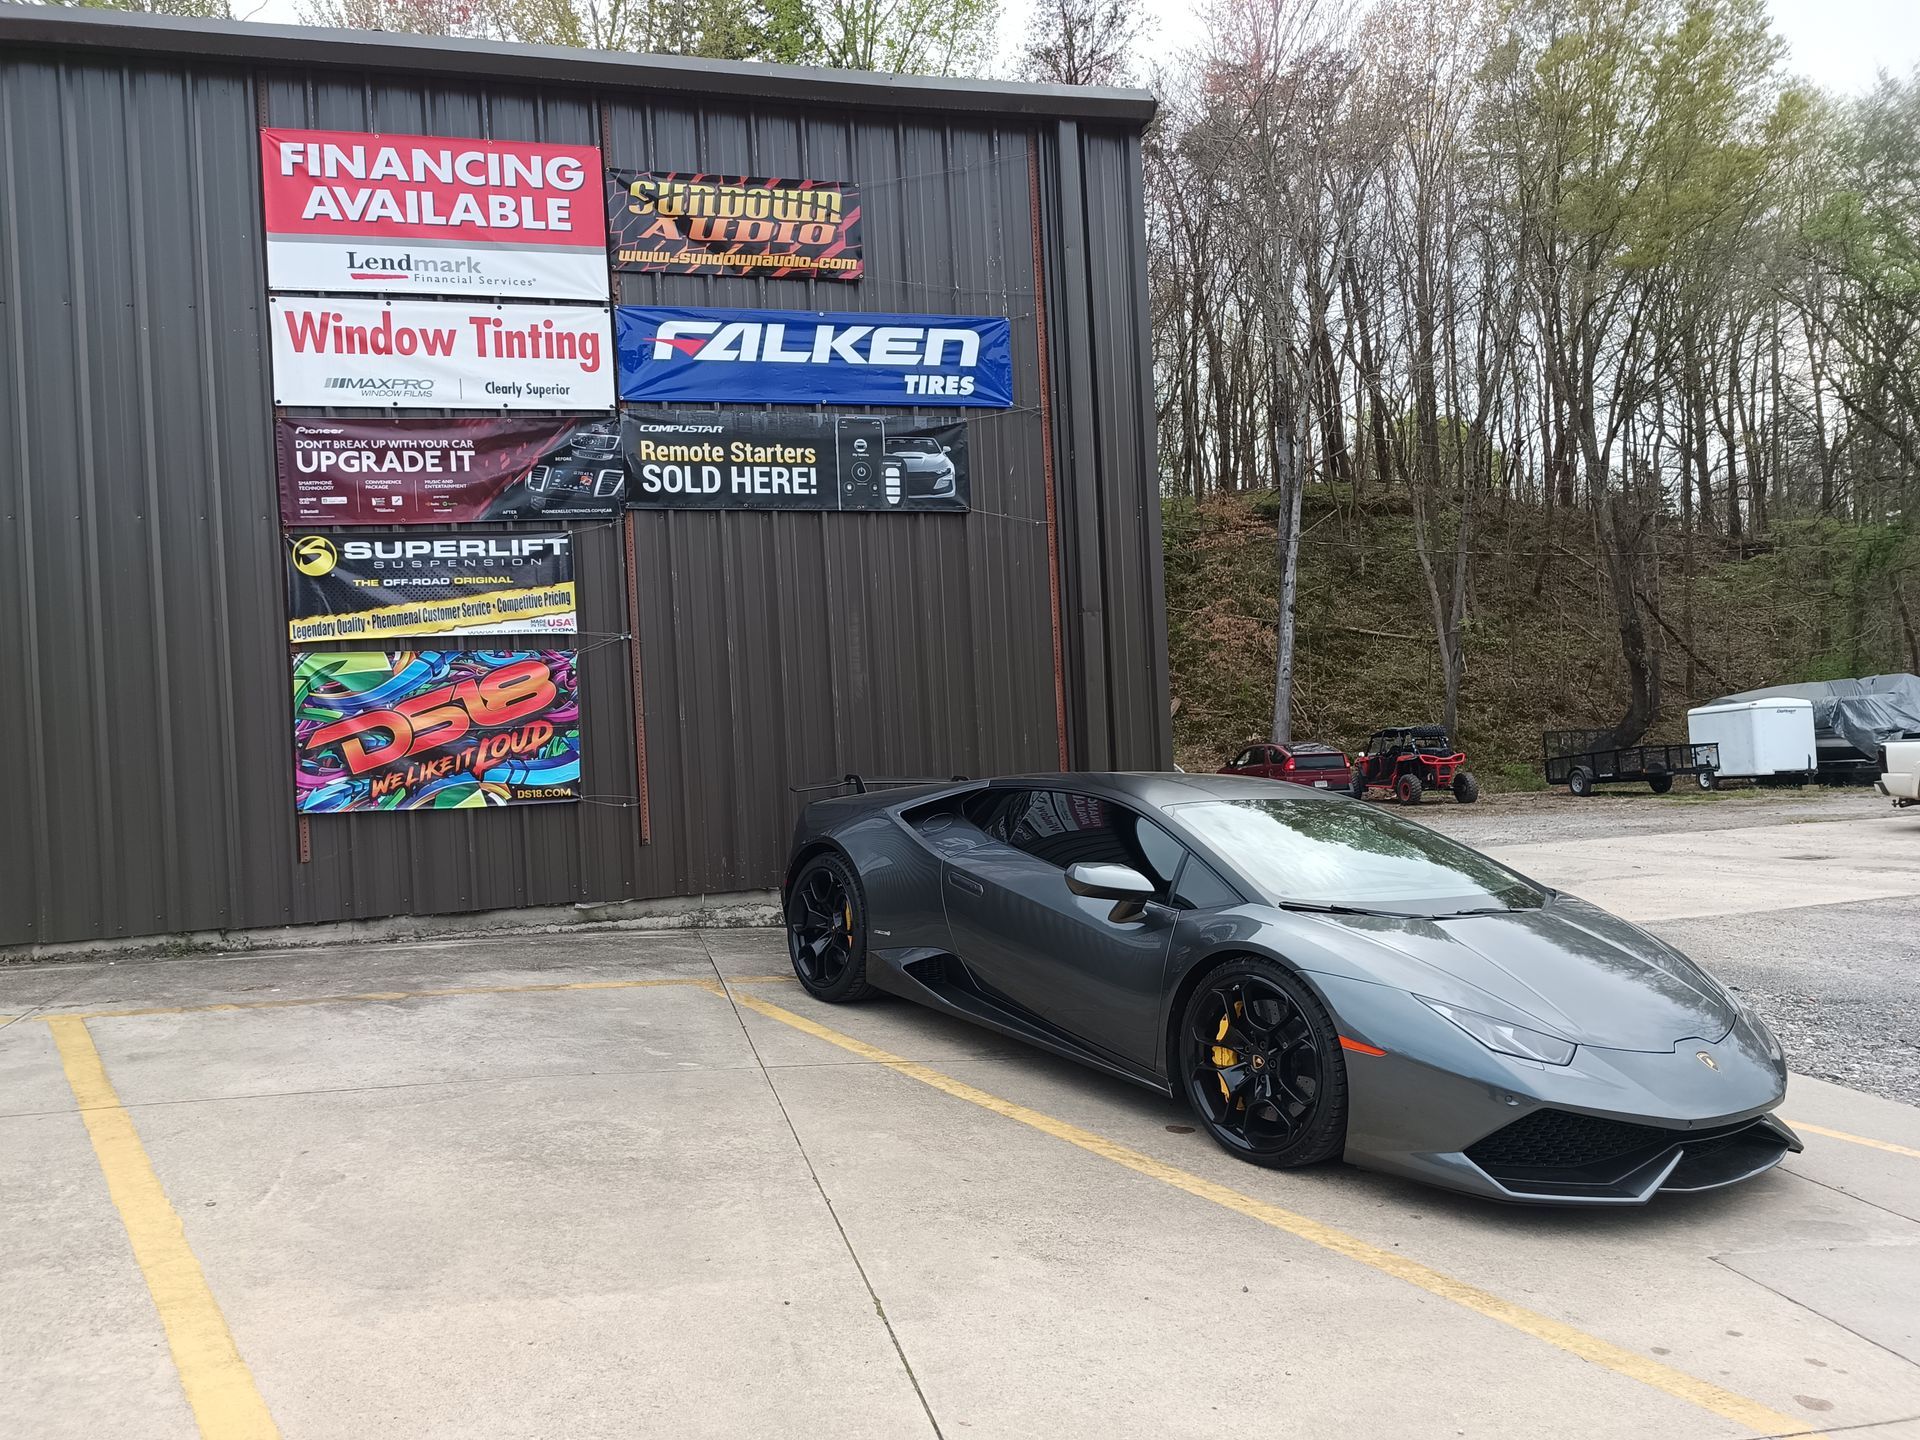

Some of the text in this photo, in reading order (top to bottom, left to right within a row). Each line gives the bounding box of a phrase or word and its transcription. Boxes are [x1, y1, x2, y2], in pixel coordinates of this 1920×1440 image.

[279, 142, 586, 191] FINANCING
[302, 186, 573, 231] AVAILABLE
[628, 180, 843, 223] SUNDOWN
[637, 216, 837, 245] AUDIO
[346, 251, 482, 273] Lendmark
[414, 273, 472, 284] Financial
[284, 310, 601, 373] Window Tinting
[652, 320, 981, 367] FALKEN
[345, 377, 435, 390] MAXPRO
[361, 390, 433, 398] WINDOW FILMS
[485, 382, 571, 398] Clearly Superior
[904, 374, 976, 396] TIRES
[295, 426, 345, 435] Pioneer
[639, 424, 725, 434] COMPUSTAR
[295, 440, 474, 449] DON'T BREAK UP WITH YOUR CAR
[639, 440, 817, 464] Remote Starters
[295, 450, 476, 473] UPGRADE IT
[641, 464, 818, 495] SOLD HERE!
[343, 538, 569, 560] SUPERLIFT
[373, 557, 543, 569] SUSPENSION
[353, 576, 514, 587] THE OFF-ROAD ORIGINAL
[292, 590, 571, 640] Legendary Quality Phenomenal Customer Service Competitive Pricing
[547, 618, 571, 627] USA
[305, 660, 558, 776] DS18
[370, 720, 555, 798] WE LIKE IT LOUD
[516, 787, 572, 800] DS18.COM
